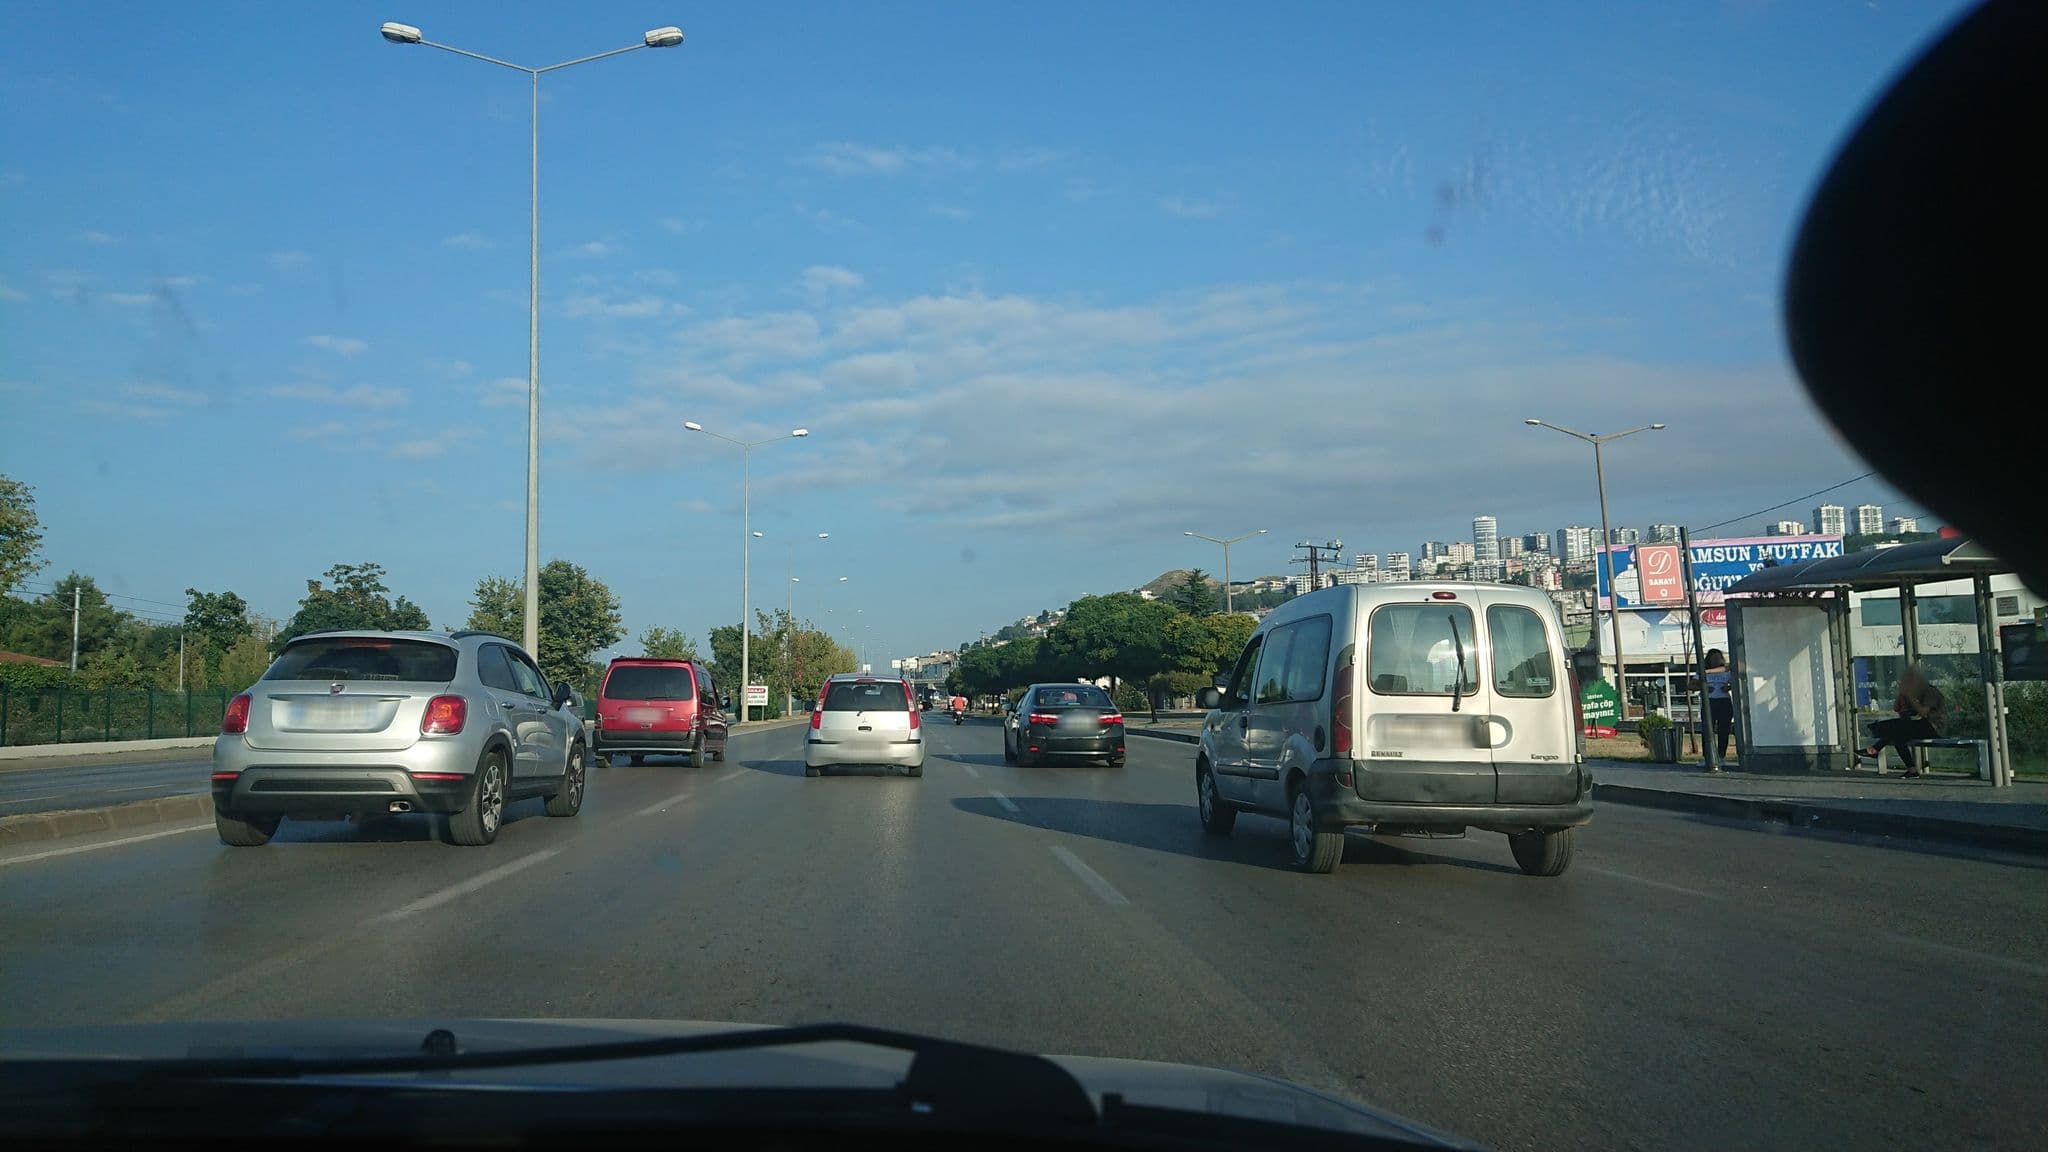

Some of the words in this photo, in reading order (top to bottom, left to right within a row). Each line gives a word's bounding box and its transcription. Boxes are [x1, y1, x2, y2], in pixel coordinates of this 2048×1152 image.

[1757, 542, 1840, 561] MUTFAK
[1648, 550, 1672, 575] D
[1600, 700, 1613, 709] çöp
[1583, 710, 1614, 719] mayınız
